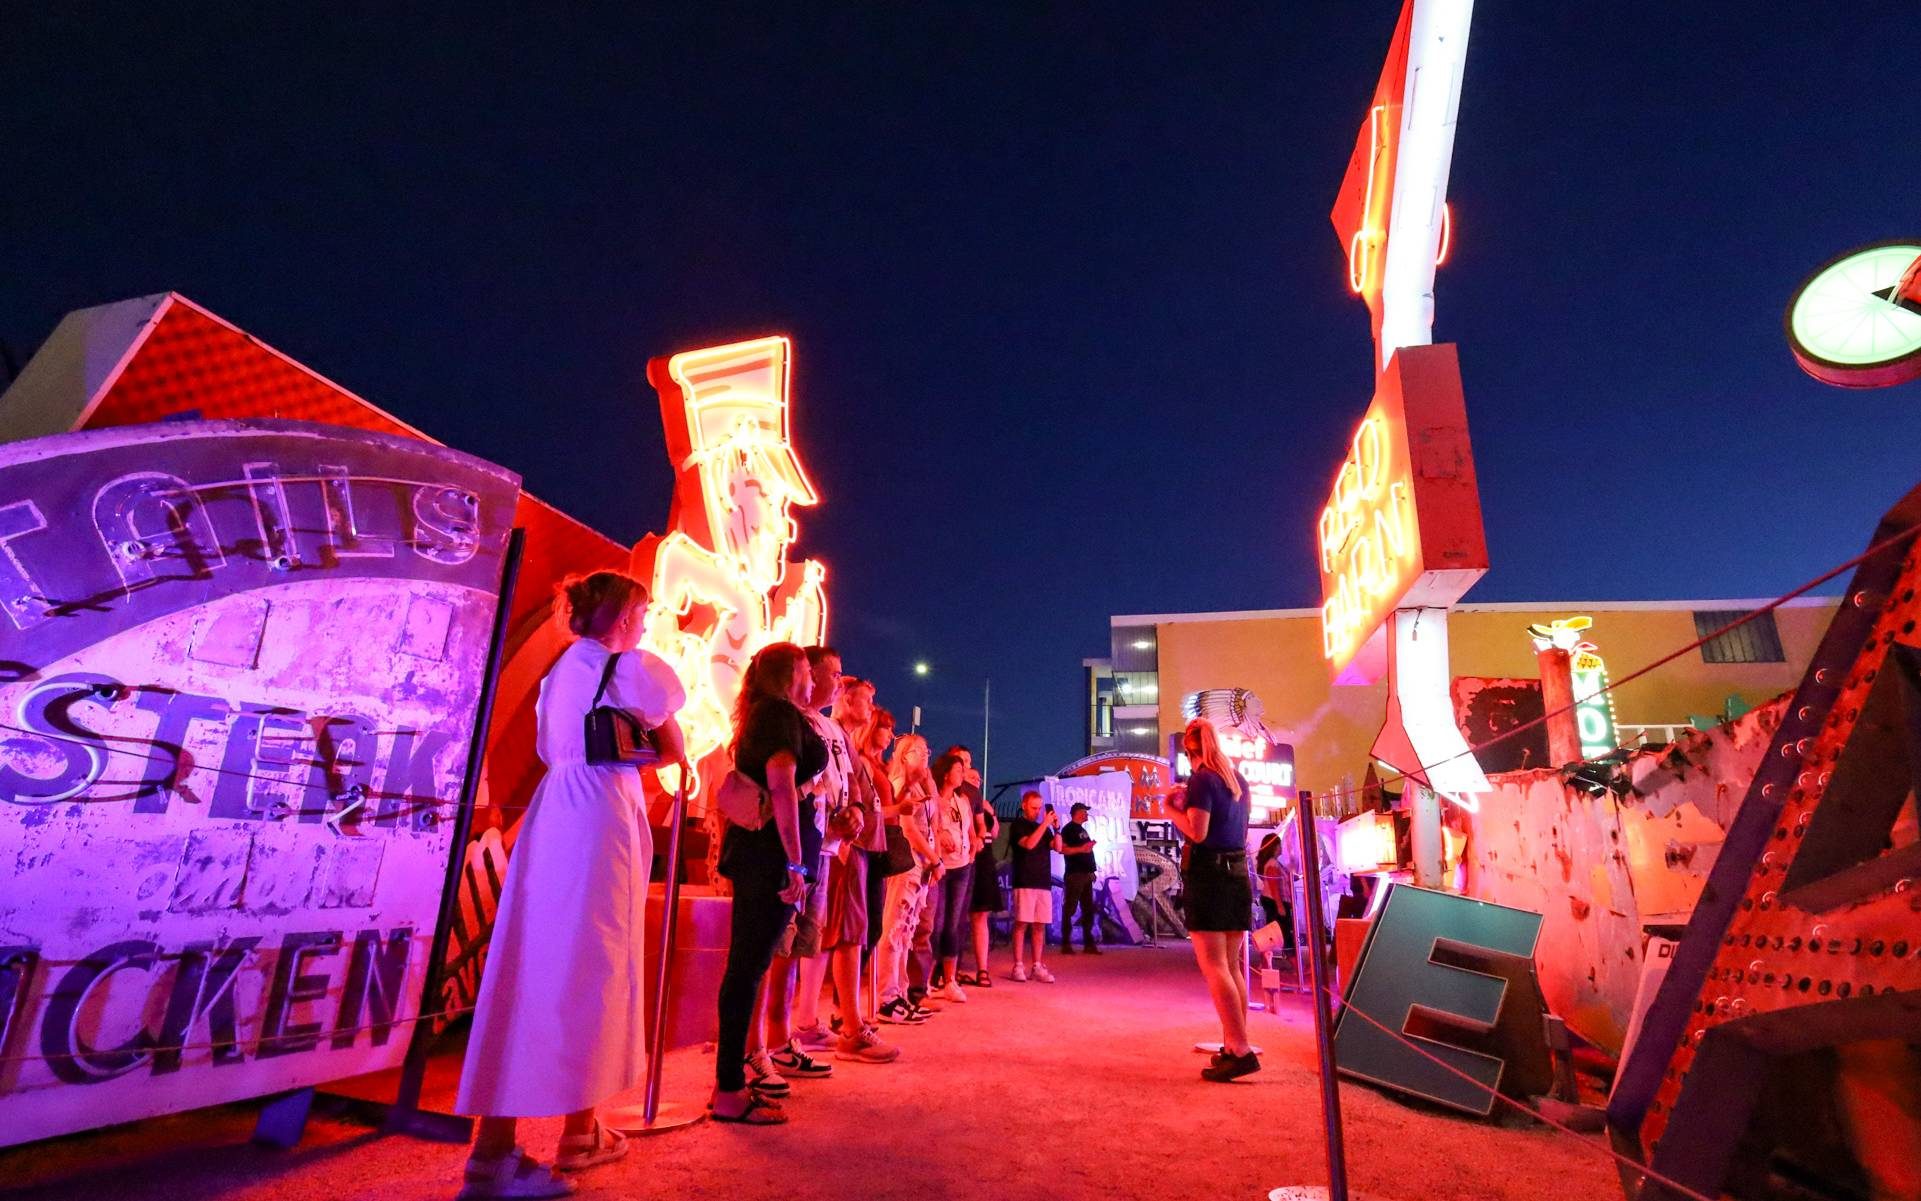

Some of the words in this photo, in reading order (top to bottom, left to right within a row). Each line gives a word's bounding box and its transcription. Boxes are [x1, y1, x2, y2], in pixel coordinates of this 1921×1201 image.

[1319, 417, 1384, 573] RED
[1321, 481, 1405, 659] BARN
[0, 672, 450, 834] STEAK
[1044, 775, 1126, 811] TROPICANA
